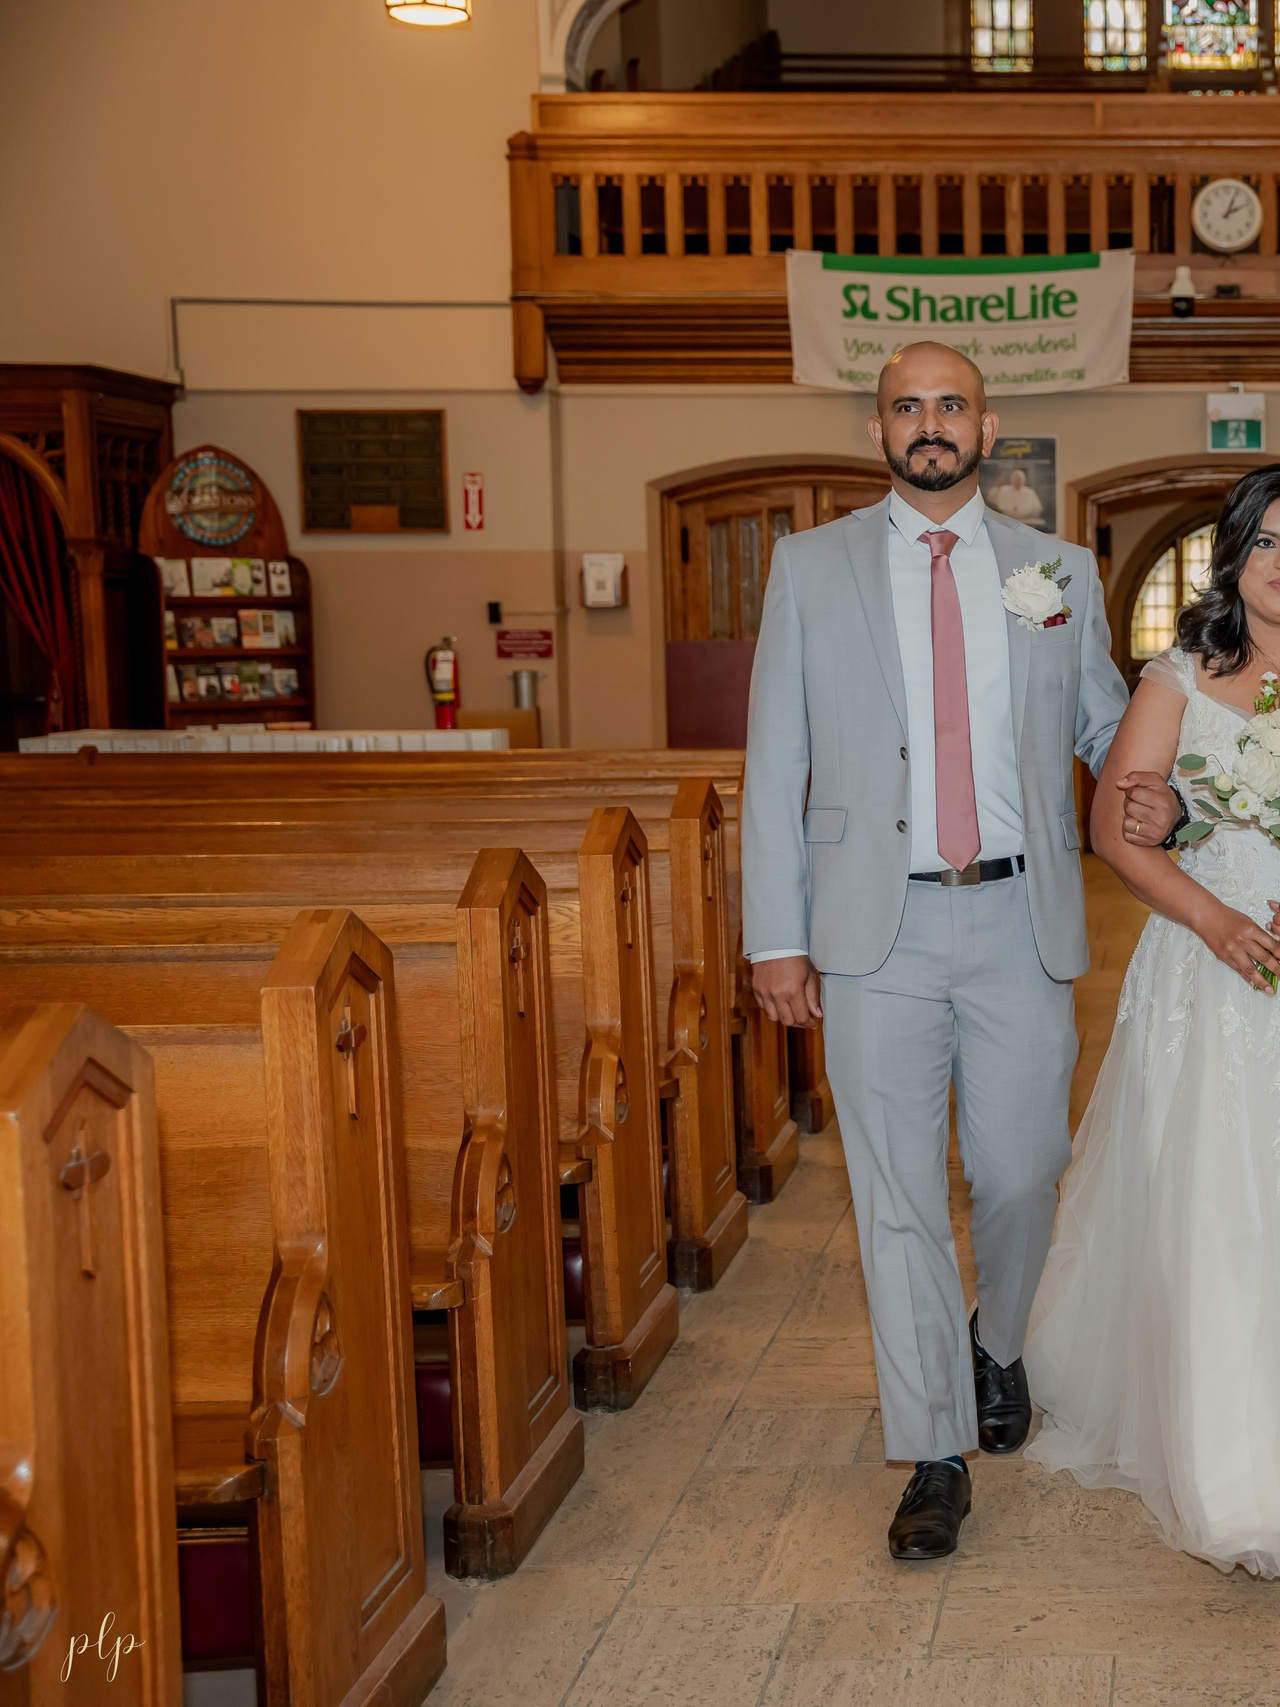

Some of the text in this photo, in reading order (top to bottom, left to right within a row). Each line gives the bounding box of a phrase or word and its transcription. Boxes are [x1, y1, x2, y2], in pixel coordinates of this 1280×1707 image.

[885, 283, 1078, 323] ShareLife
[952, 337, 984, 357] ork
[990, 332, 1077, 357] wonders!
